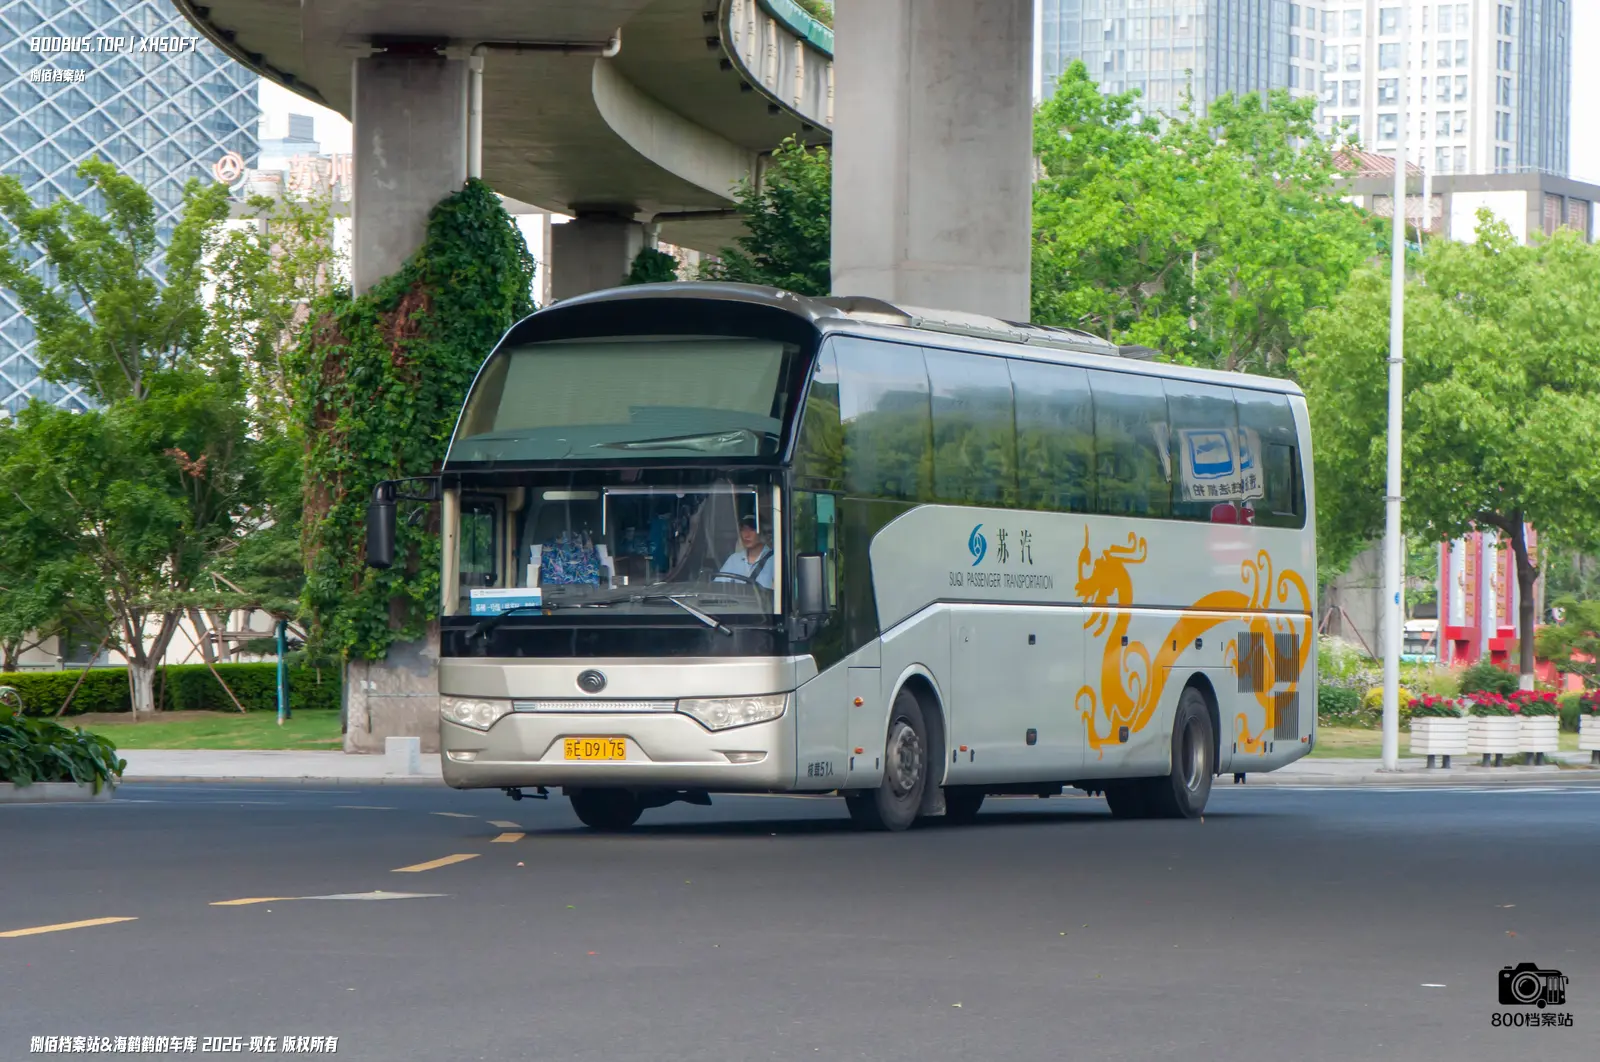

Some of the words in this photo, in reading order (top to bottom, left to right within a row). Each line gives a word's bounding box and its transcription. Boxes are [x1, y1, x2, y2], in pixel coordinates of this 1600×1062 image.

[996, 528, 1033, 565] 苏汽
[949, 571, 964, 586] SUQI
[966, 572, 1002, 588] PASSENGER
[1003, 573, 1053, 589] TRANSPORTATION
